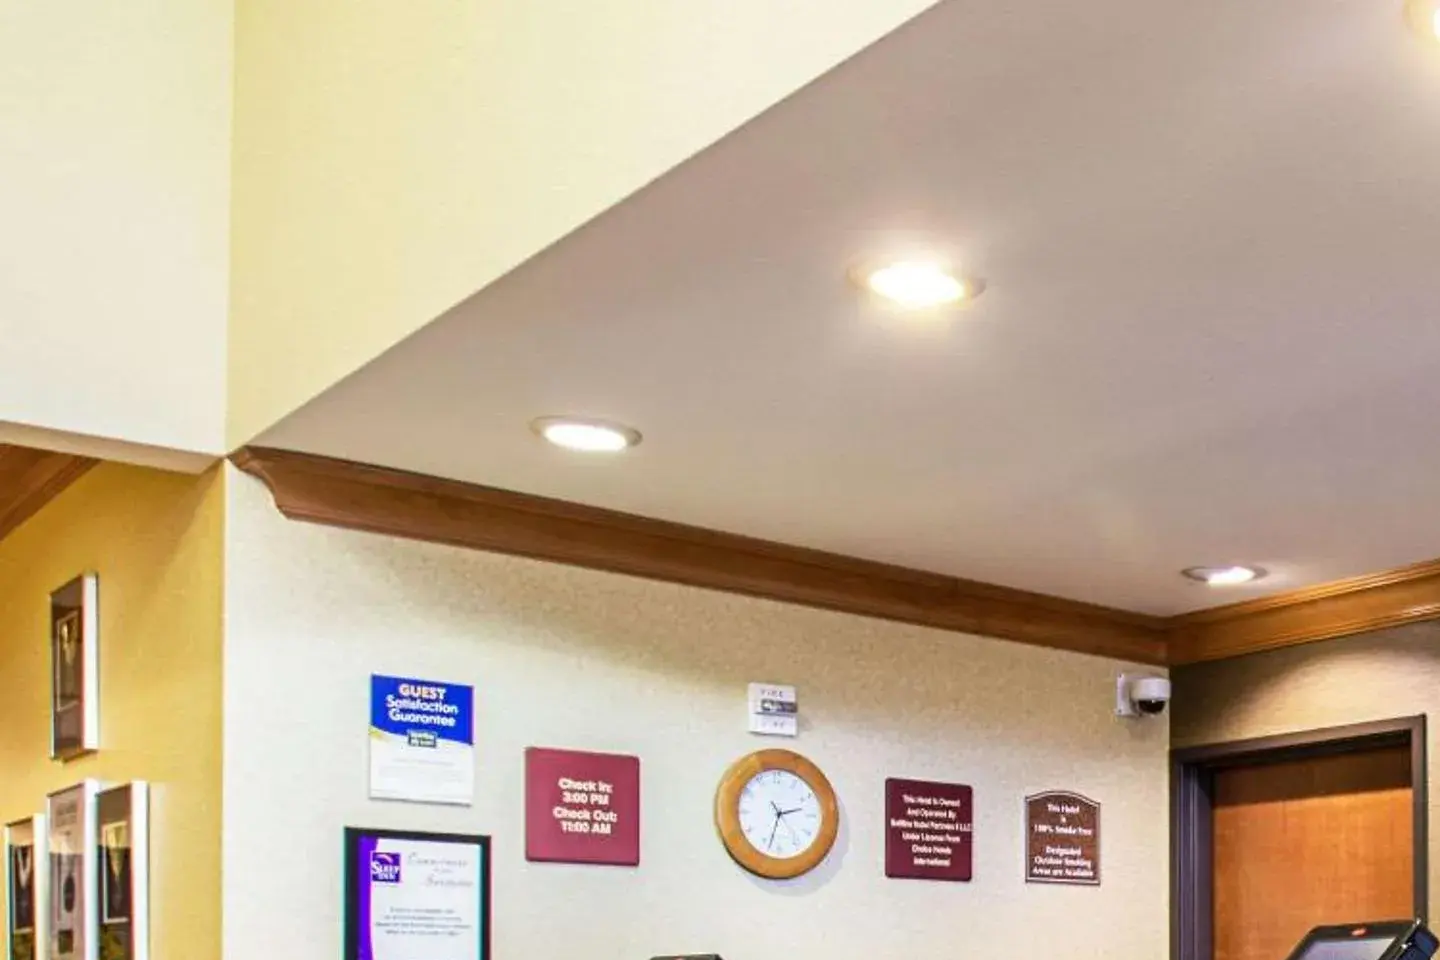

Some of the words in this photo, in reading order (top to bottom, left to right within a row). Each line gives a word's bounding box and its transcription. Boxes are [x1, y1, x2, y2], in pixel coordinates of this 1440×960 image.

[398, 683, 447, 700] GUEST
[385, 694, 459, 715] Satisfaction
[388, 707, 456, 727] Guarantee
[558, 777, 597, 792] Check
[562, 791, 588, 804] 3:00
[589, 794, 609, 806] PM
[552, 805, 591, 820] Check
[561, 821, 590, 834] 11:00
[591, 823, 612, 834] AM
[370, 860, 401, 875] SLEEP
